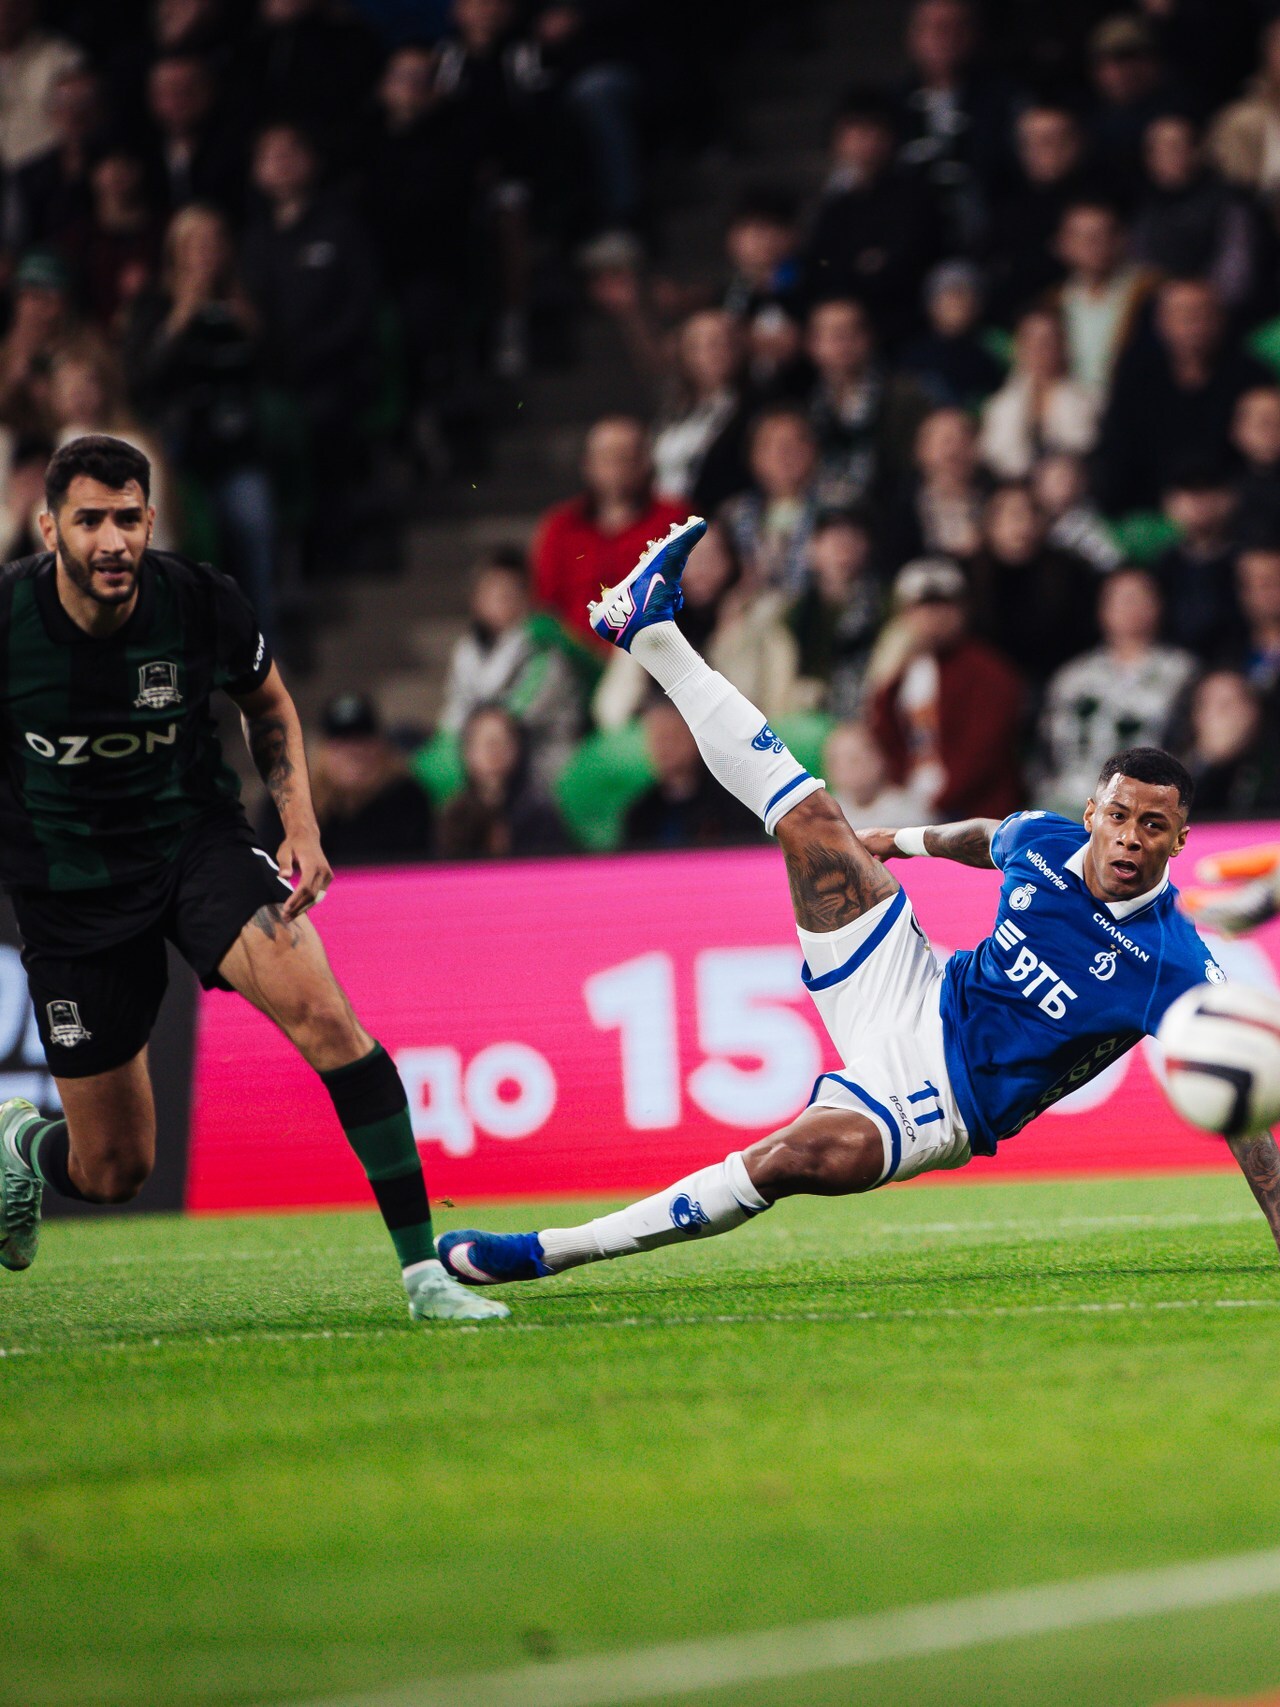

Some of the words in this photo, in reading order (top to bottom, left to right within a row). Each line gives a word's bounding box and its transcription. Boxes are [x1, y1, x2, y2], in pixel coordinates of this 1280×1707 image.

[25, 723, 176, 765] OZON
[1026, 848, 1068, 890] wildberries
[1093, 912, 1150, 962] CHANGAN
[1004, 945, 1078, 1019] ВТБ
[889, 1095, 915, 1138] BOSCO
[906, 1080, 945, 1126] 11
